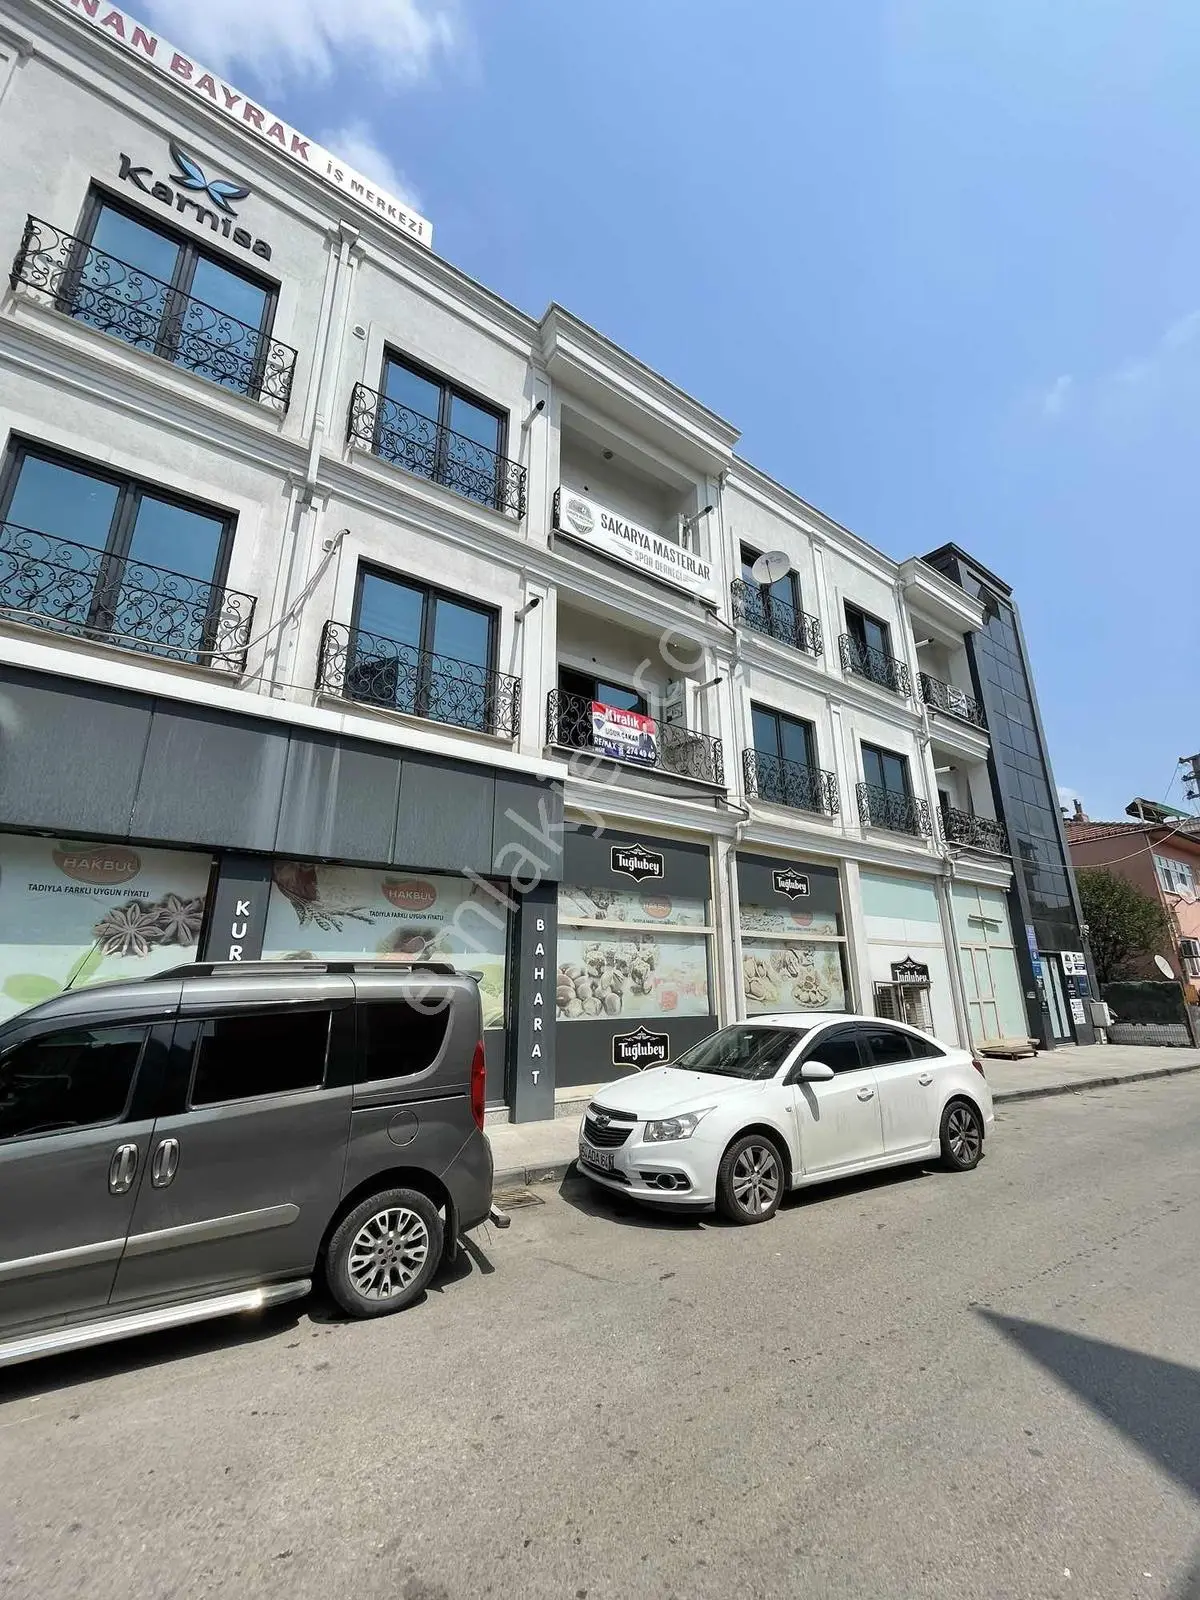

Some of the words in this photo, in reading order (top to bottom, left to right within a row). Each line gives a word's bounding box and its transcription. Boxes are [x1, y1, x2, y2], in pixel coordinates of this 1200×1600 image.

[170, 52, 312, 162] BAYRAK
[327, 160, 344, 183] İŞ
[350, 179, 423, 236] MERKEZİ
[600, 513, 651, 551] SAKARYA
[653, 540, 711, 581] MASTERLAR
[634, 550, 654, 568] SPOR
[604, 707, 640, 729] Kiralık
[593, 736, 617, 751] RE/MAX
[626, 746, 639, 756] 274
[617, 853, 660, 875] Tuğlubey
[28, 883, 62, 893] TADIYLA
[64, 885, 92, 895] FARKLI
[93, 888, 121, 897] UYGUN
[123, 889, 150, 898] FİYATLI
[776, 875, 807, 892] Tuğlubey
[389, 889, 434, 901] HAKBUL
[531, 919, 545, 1085] BAHARAT
[619, 1042, 665, 1059] Tuğlubey
